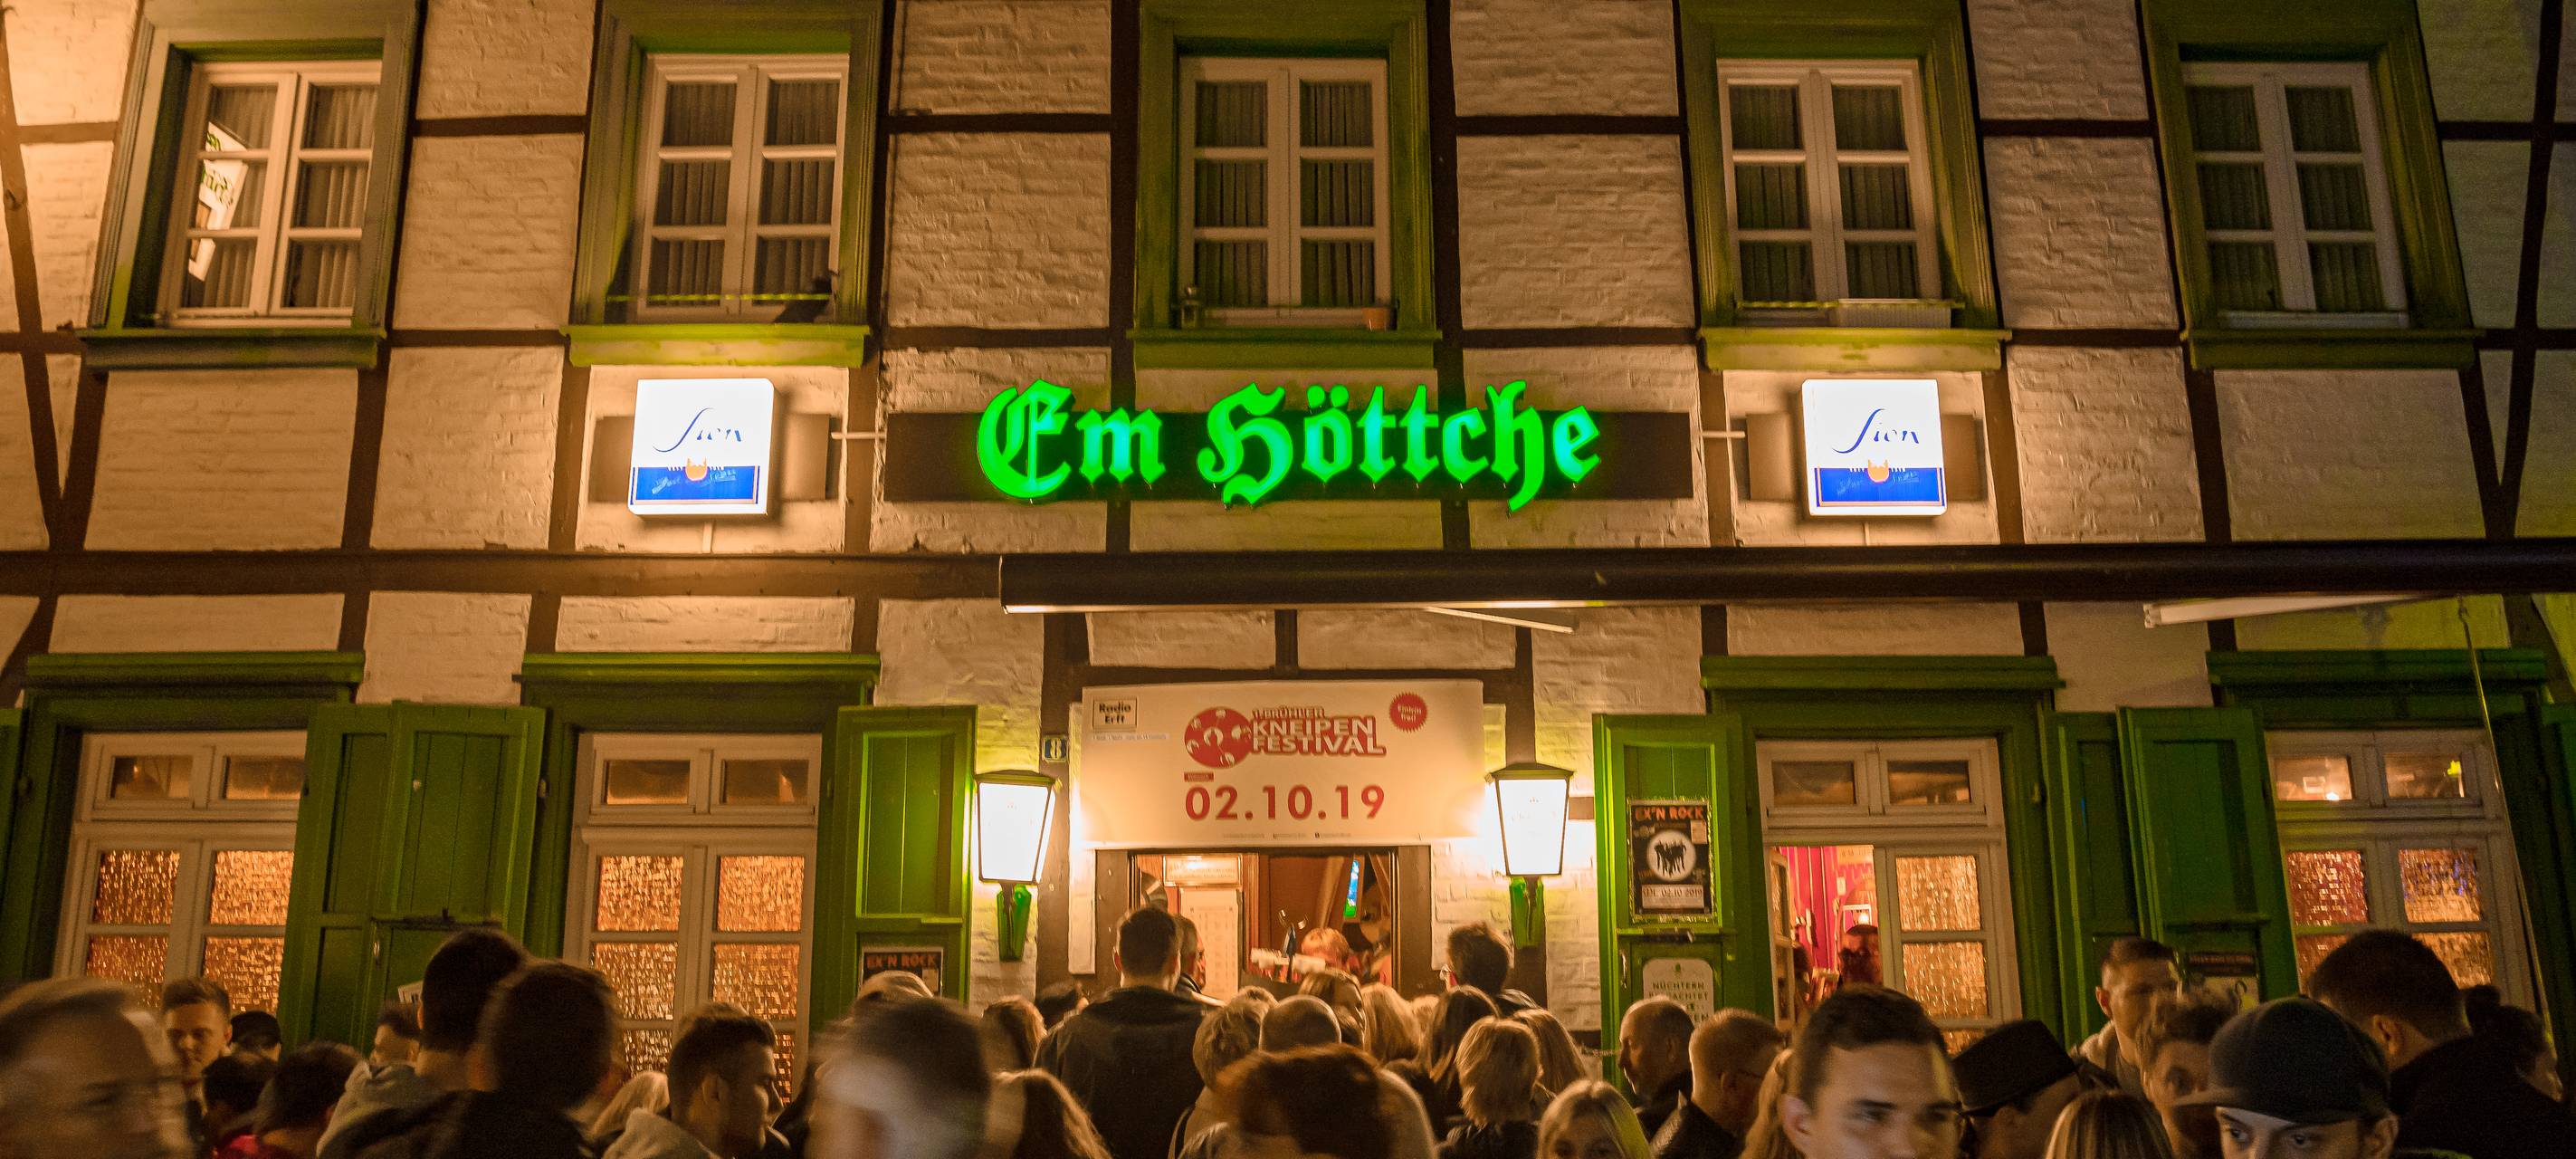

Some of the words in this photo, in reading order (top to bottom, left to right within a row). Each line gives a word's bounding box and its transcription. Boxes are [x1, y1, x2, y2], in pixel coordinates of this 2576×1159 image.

[977, 379, 1166, 497] Em
[1197, 380, 1600, 512] Höttche
[1099, 702, 1131, 714] Radio
[1253, 718, 1374, 737] KNEIPEN
[1253, 735, 1385, 754] FESTIVAL
[1185, 784, 1385, 821] 02.10.19
[1669, 805, 1703, 819] ROCK
[901, 954, 936, 967] ROCK
